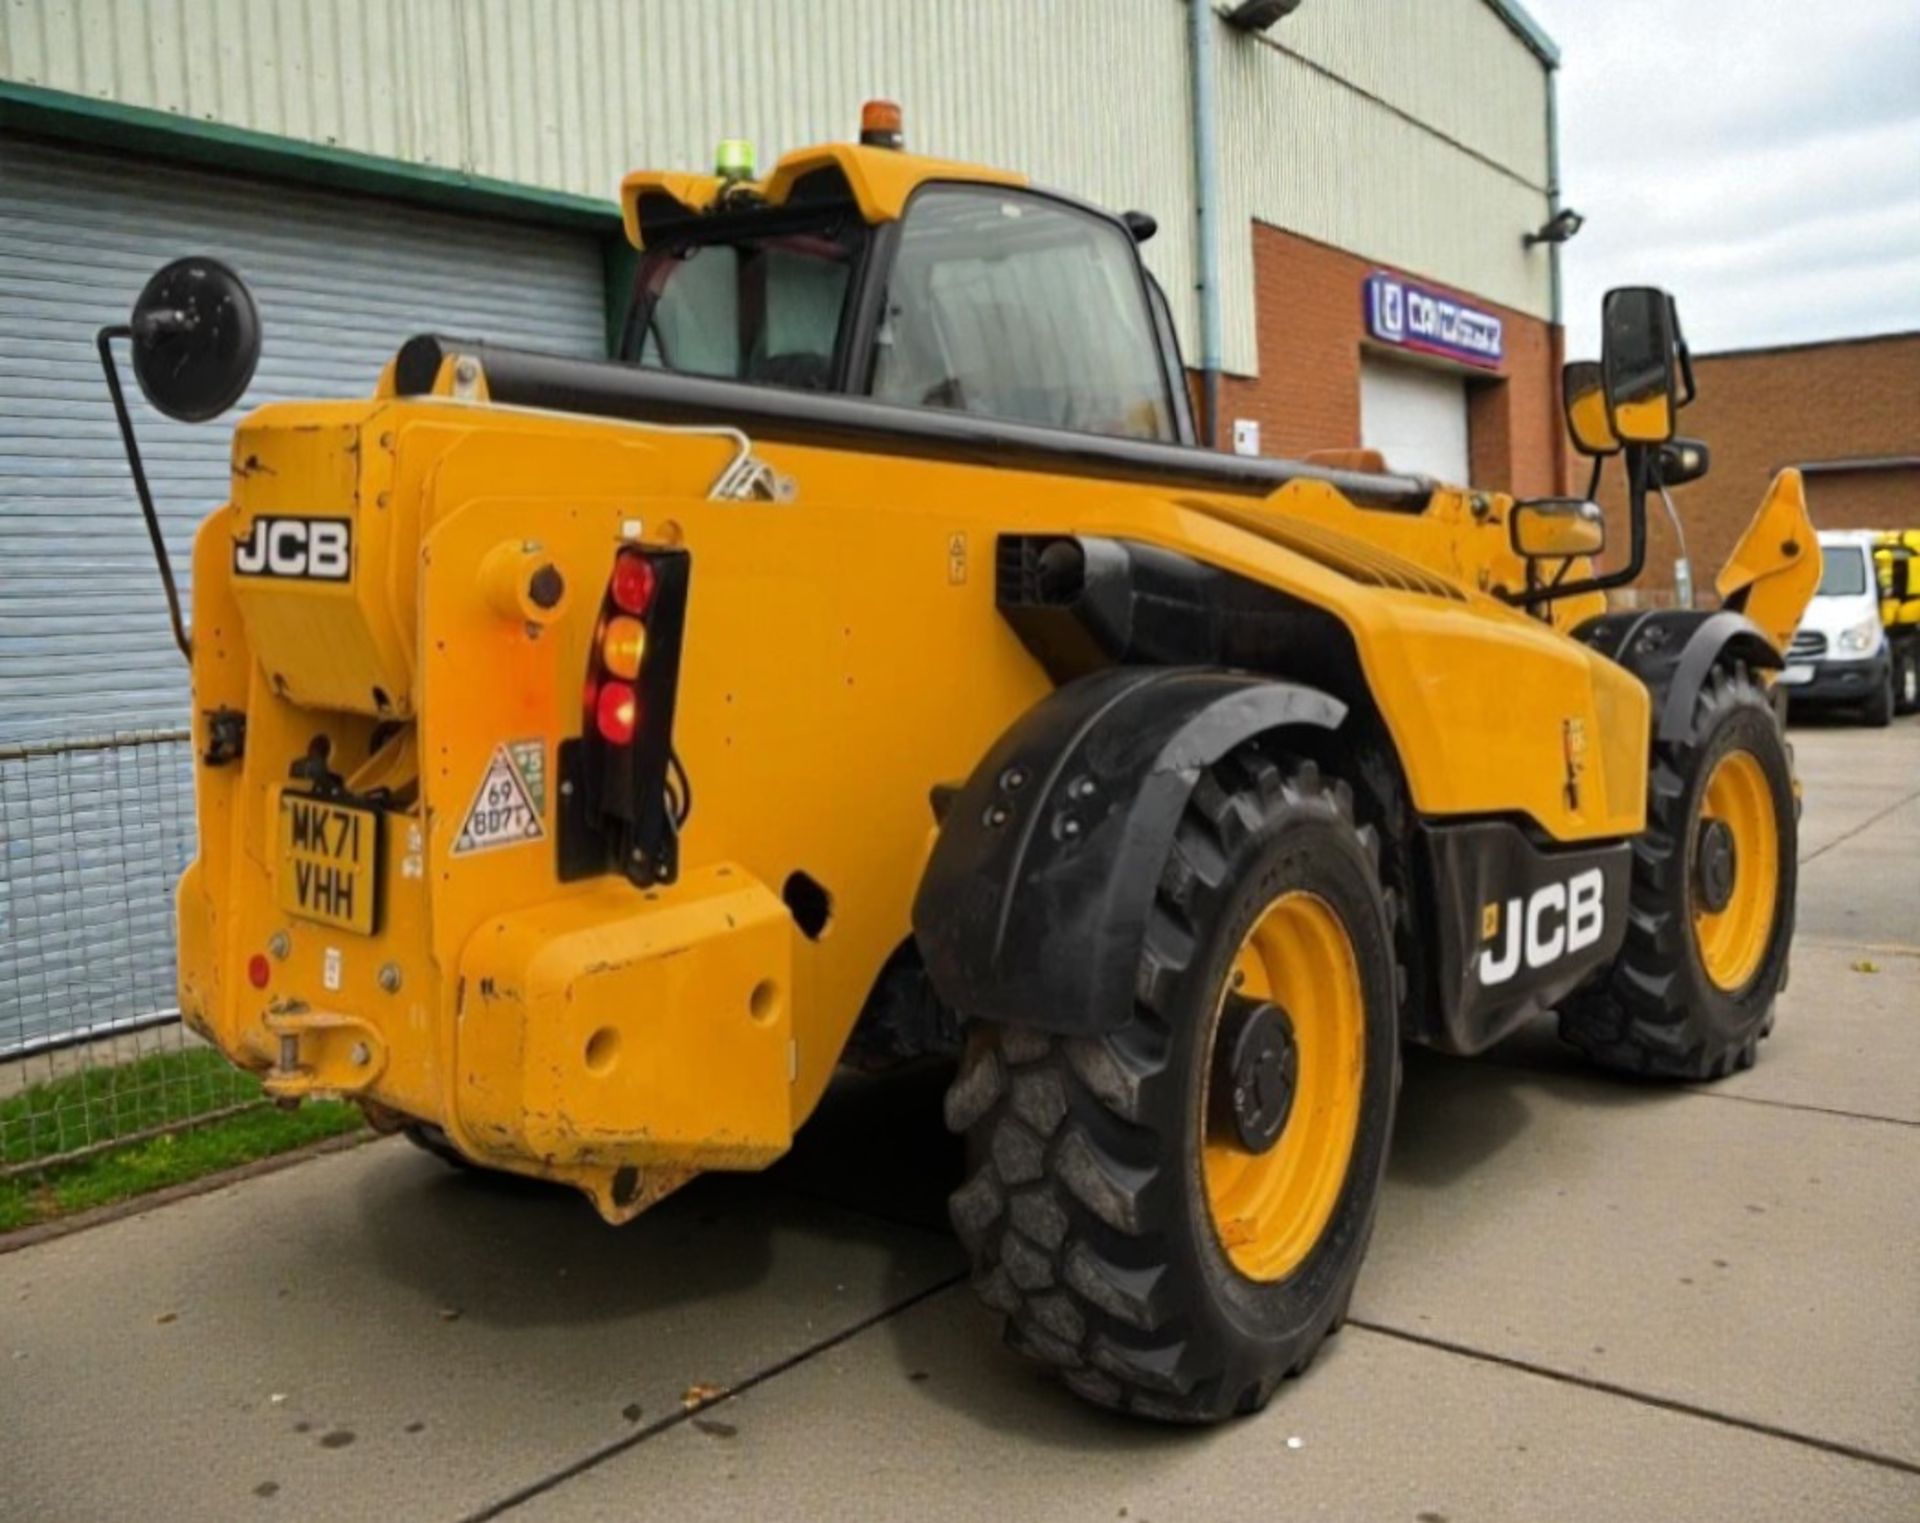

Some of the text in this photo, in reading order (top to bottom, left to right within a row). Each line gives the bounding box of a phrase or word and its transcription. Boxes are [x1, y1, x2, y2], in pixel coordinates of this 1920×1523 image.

[236, 520, 348, 577] JCB
[487, 780, 512, 807] 69
[292, 803, 359, 863] MK71
[296, 859, 354, 920] VHH
[1479, 867, 1604, 985] JCB
